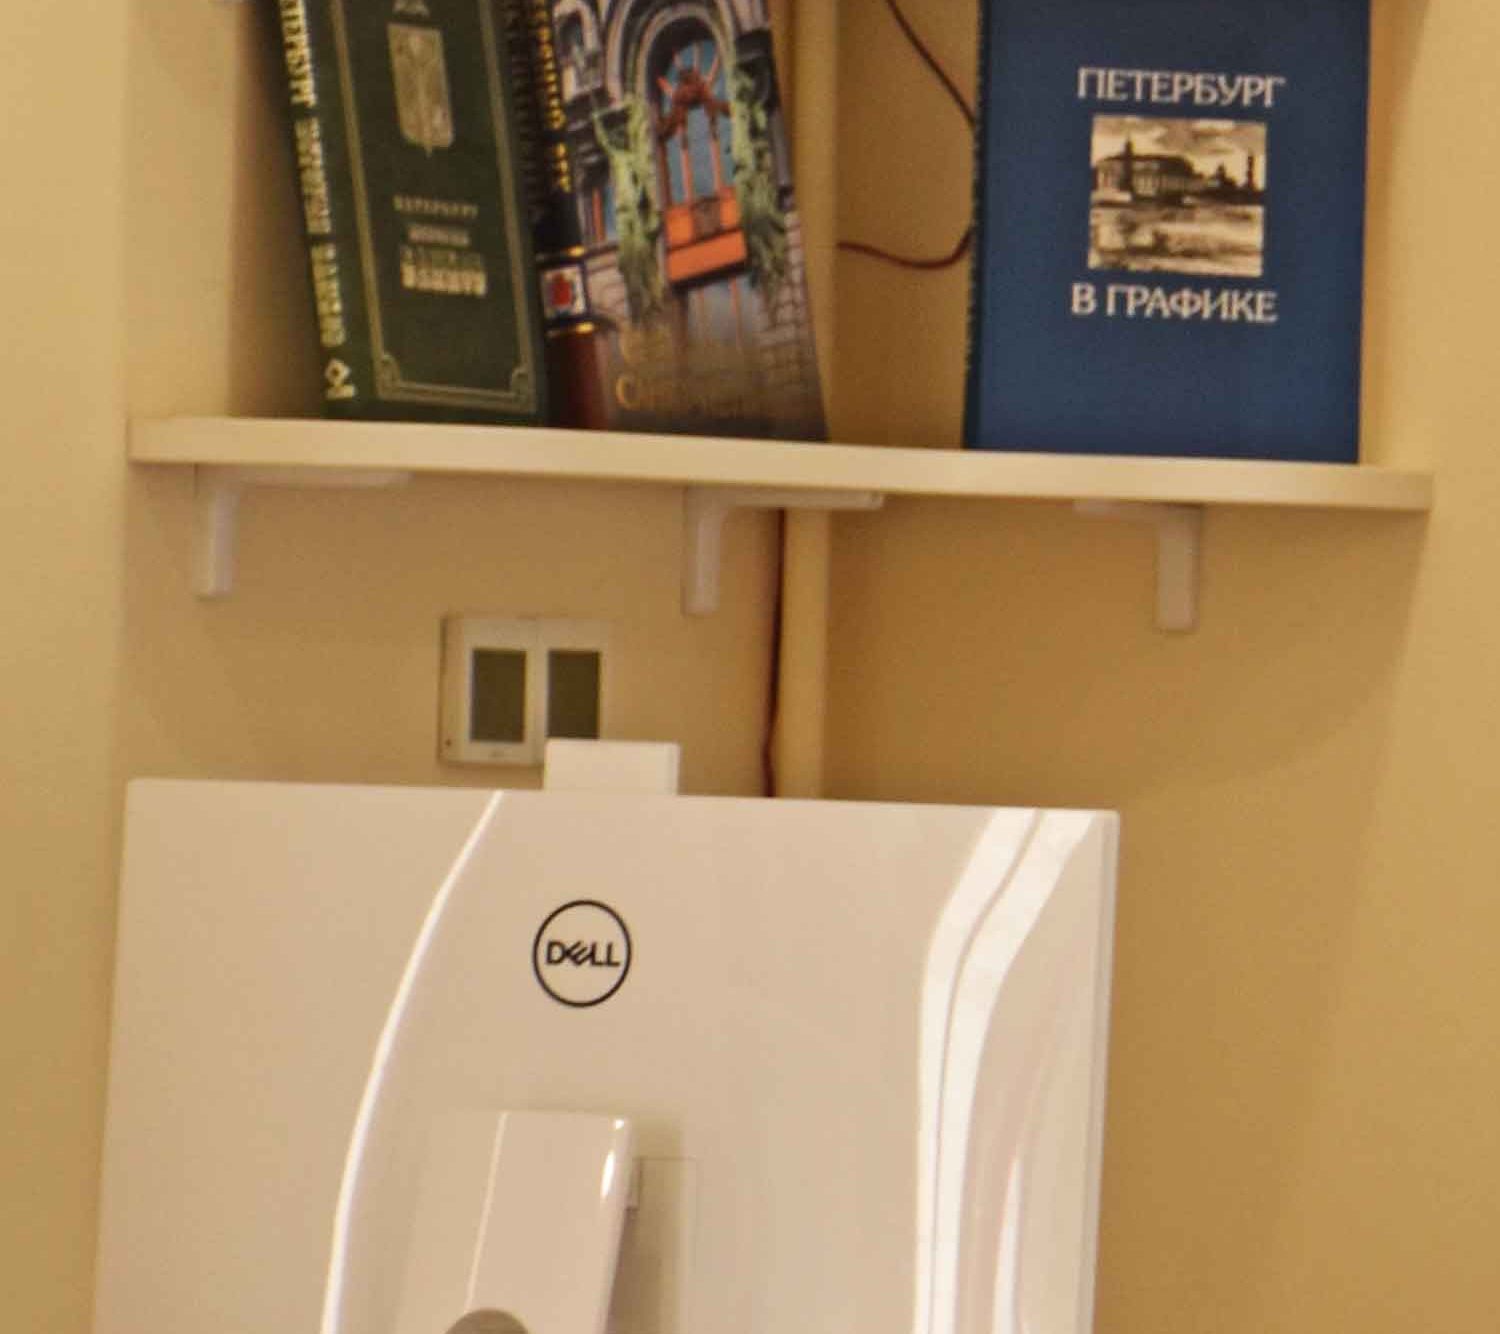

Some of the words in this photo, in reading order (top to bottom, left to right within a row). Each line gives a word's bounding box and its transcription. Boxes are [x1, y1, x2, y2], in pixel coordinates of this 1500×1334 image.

[1077, 67, 1287, 107] ПЕТЕРБУРГ
[1070, 283, 1097, 316] В
[1106, 286, 1279, 323] ГРАФИКЕ
[545, 939, 621, 967] DELL
